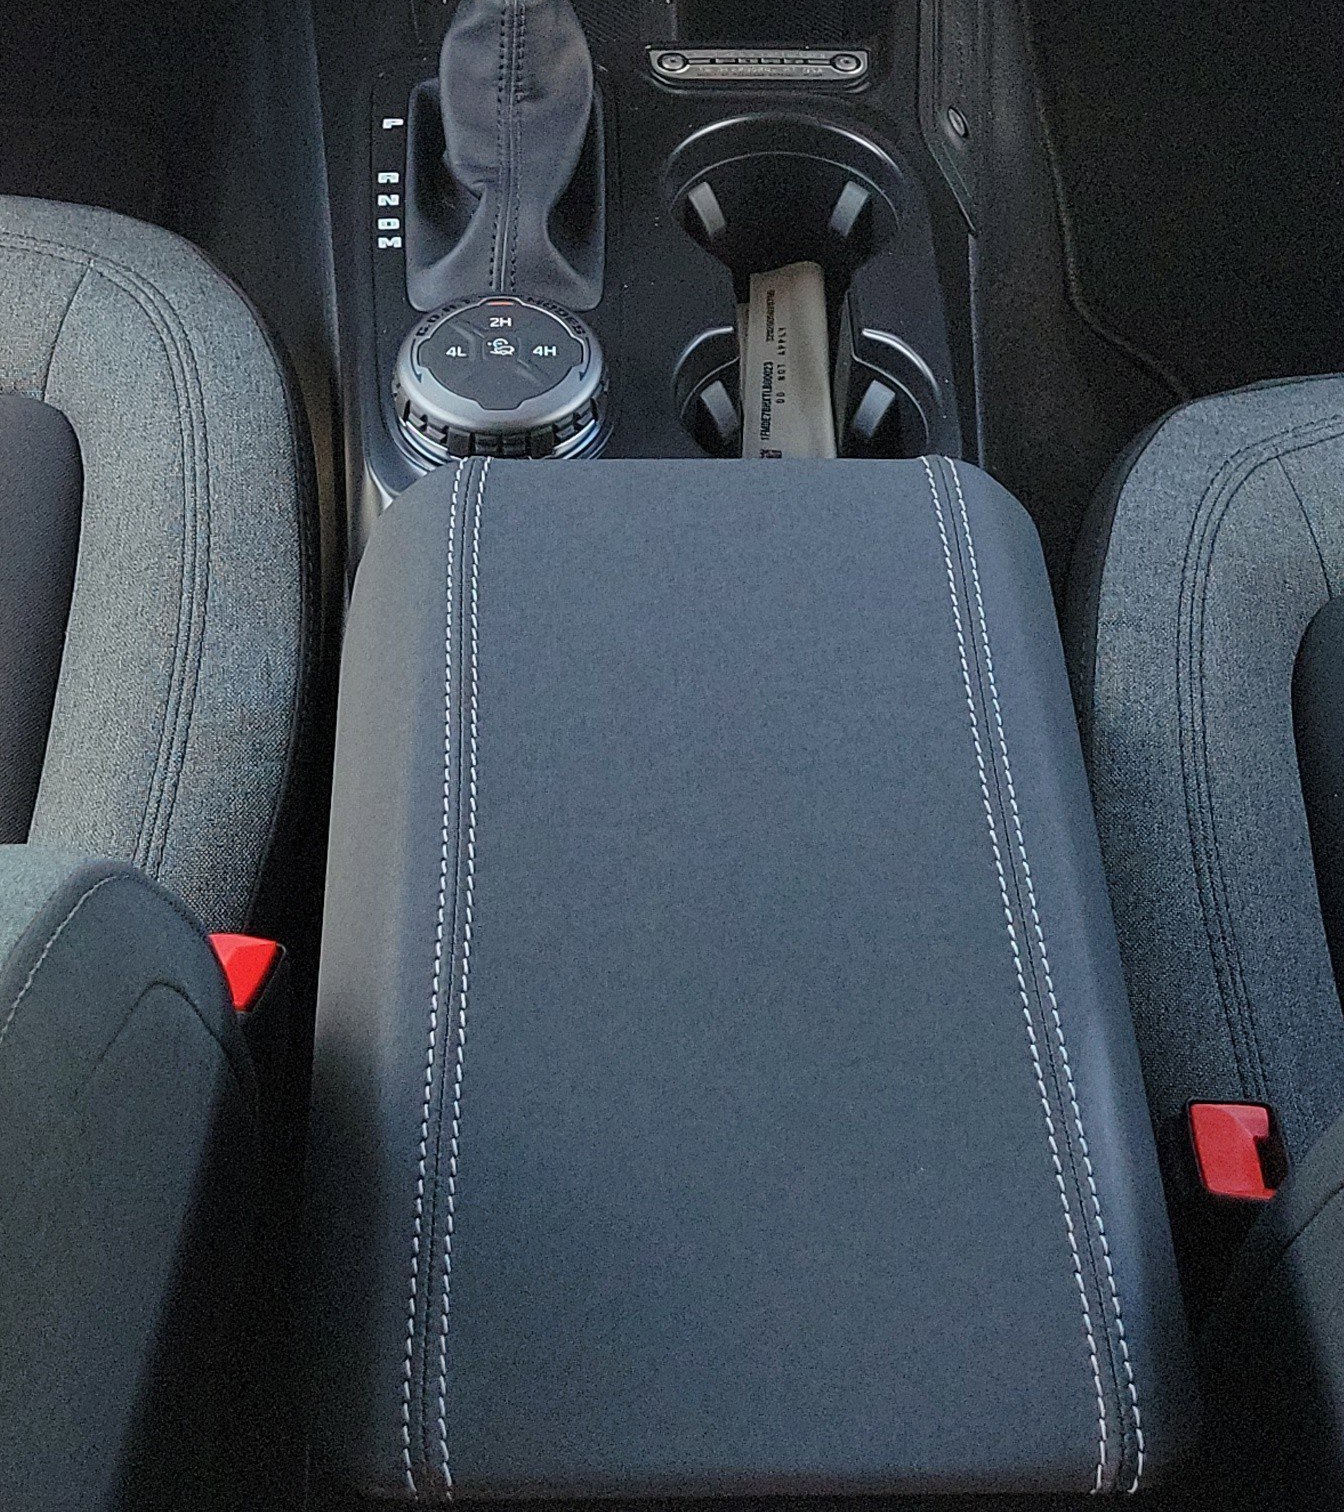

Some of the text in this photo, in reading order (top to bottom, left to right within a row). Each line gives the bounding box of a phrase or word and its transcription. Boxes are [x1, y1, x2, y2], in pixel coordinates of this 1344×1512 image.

[382, 118, 404, 130] P
[377, 194, 400, 206] N
[377, 236, 402, 249] M
[489, 317, 512, 328] 2H
[445, 346, 468, 358] 4L
[532, 345, 557, 357] 4H
